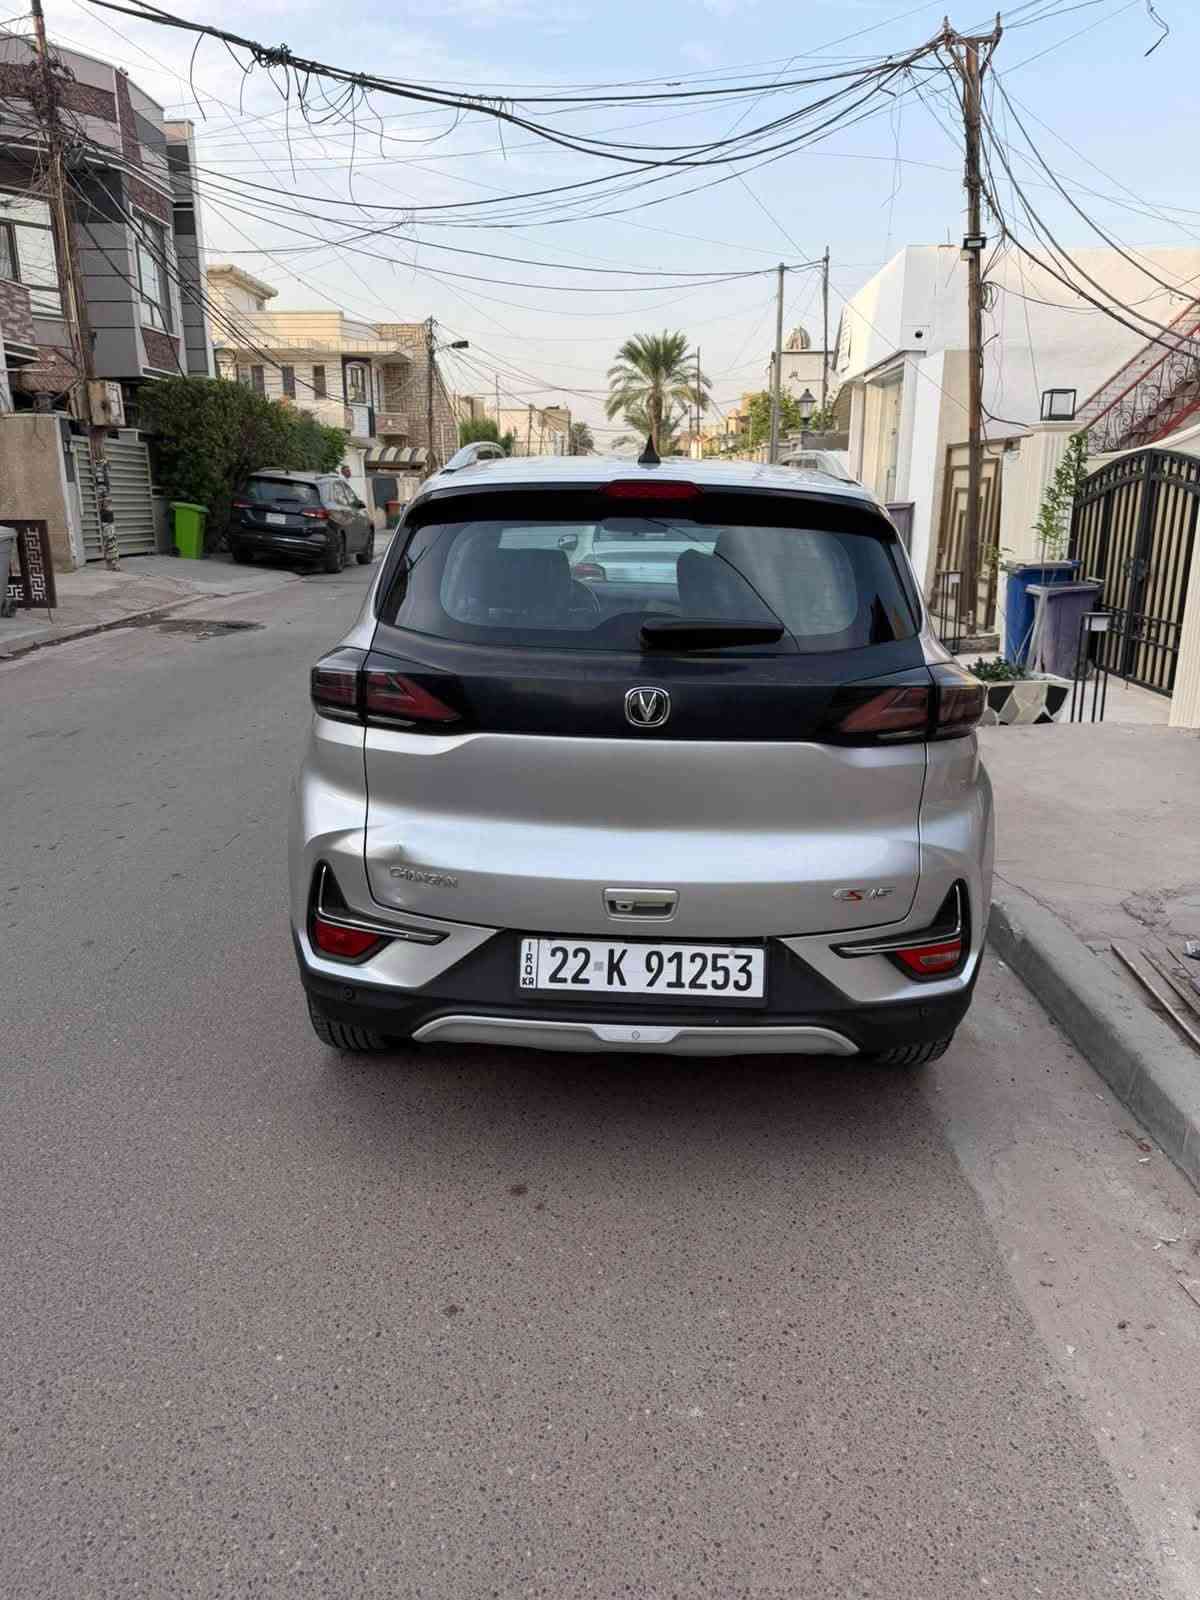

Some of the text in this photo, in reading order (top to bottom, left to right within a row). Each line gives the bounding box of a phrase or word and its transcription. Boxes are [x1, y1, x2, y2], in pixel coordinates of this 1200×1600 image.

[548, 946, 754, 992] 22 K 91253
